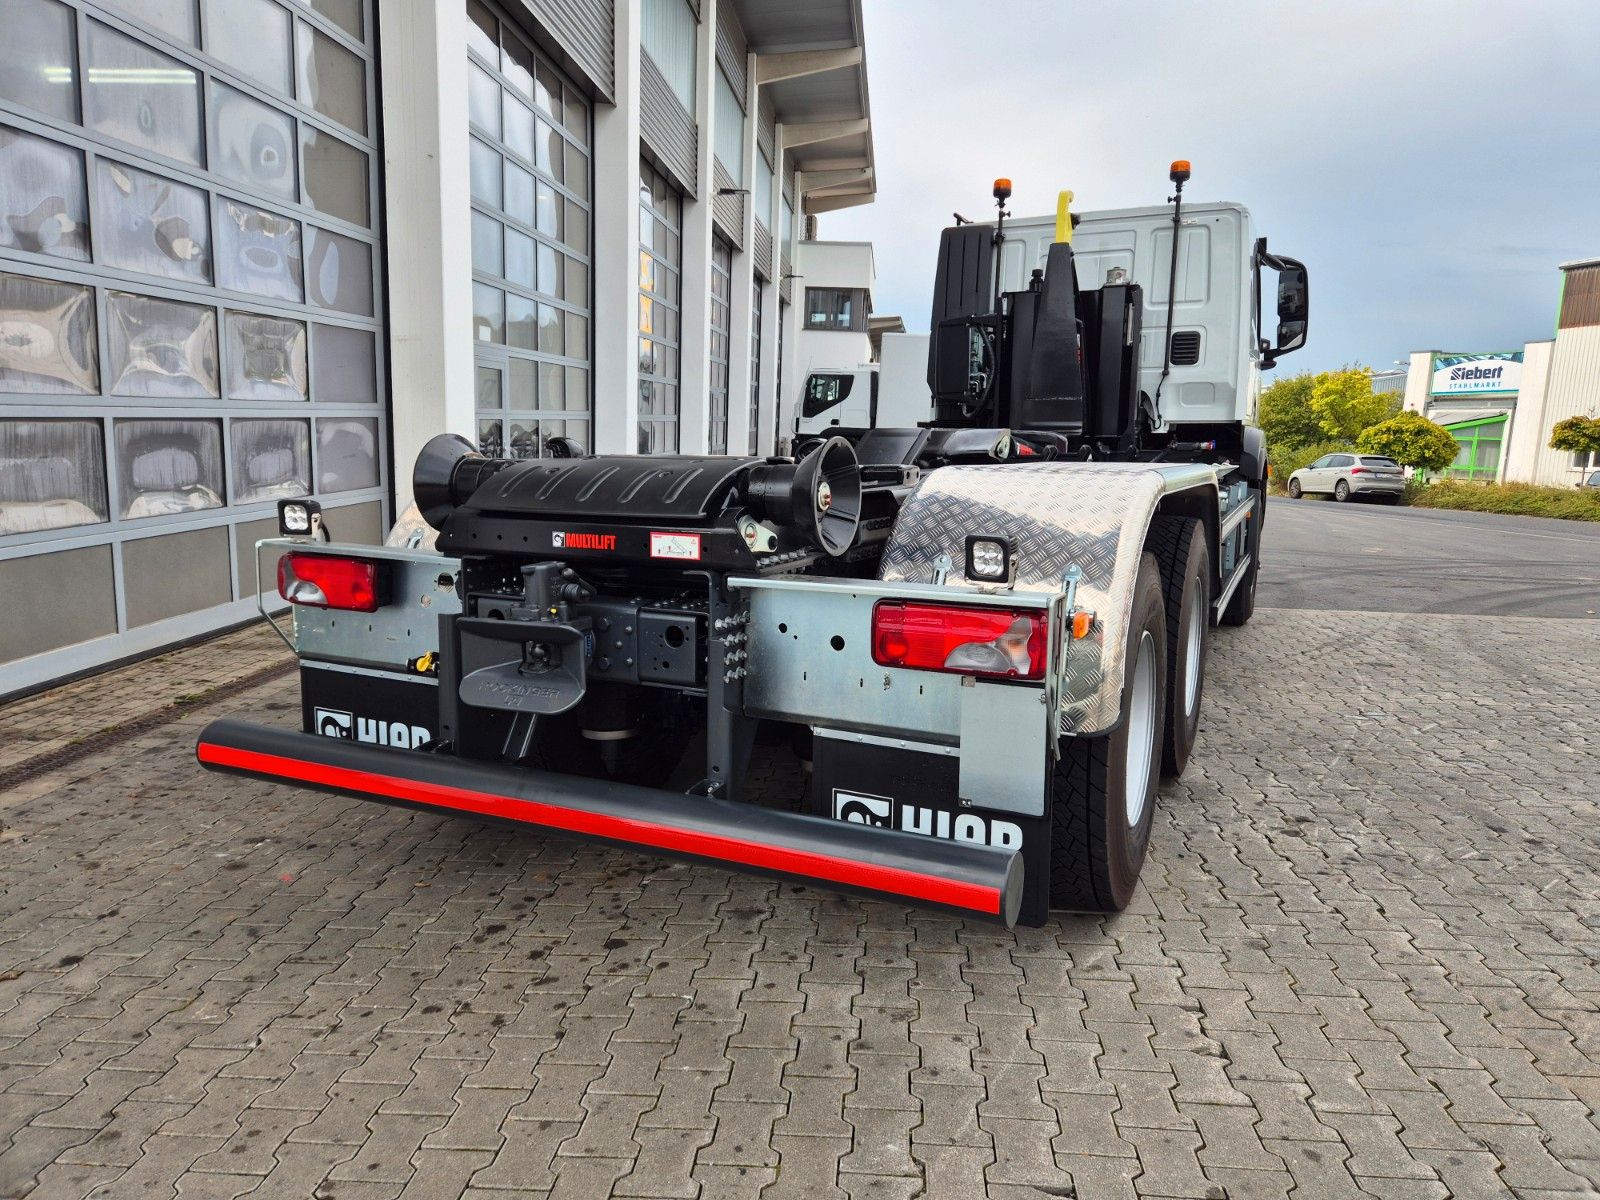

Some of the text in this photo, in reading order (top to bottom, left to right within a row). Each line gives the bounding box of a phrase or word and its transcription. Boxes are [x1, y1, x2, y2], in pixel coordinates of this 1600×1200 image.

[1450, 365, 1503, 380] Siebert
[1449, 381, 1502, 389] STAHLMARKT
[565, 533, 616, 550] MULTILIFT
